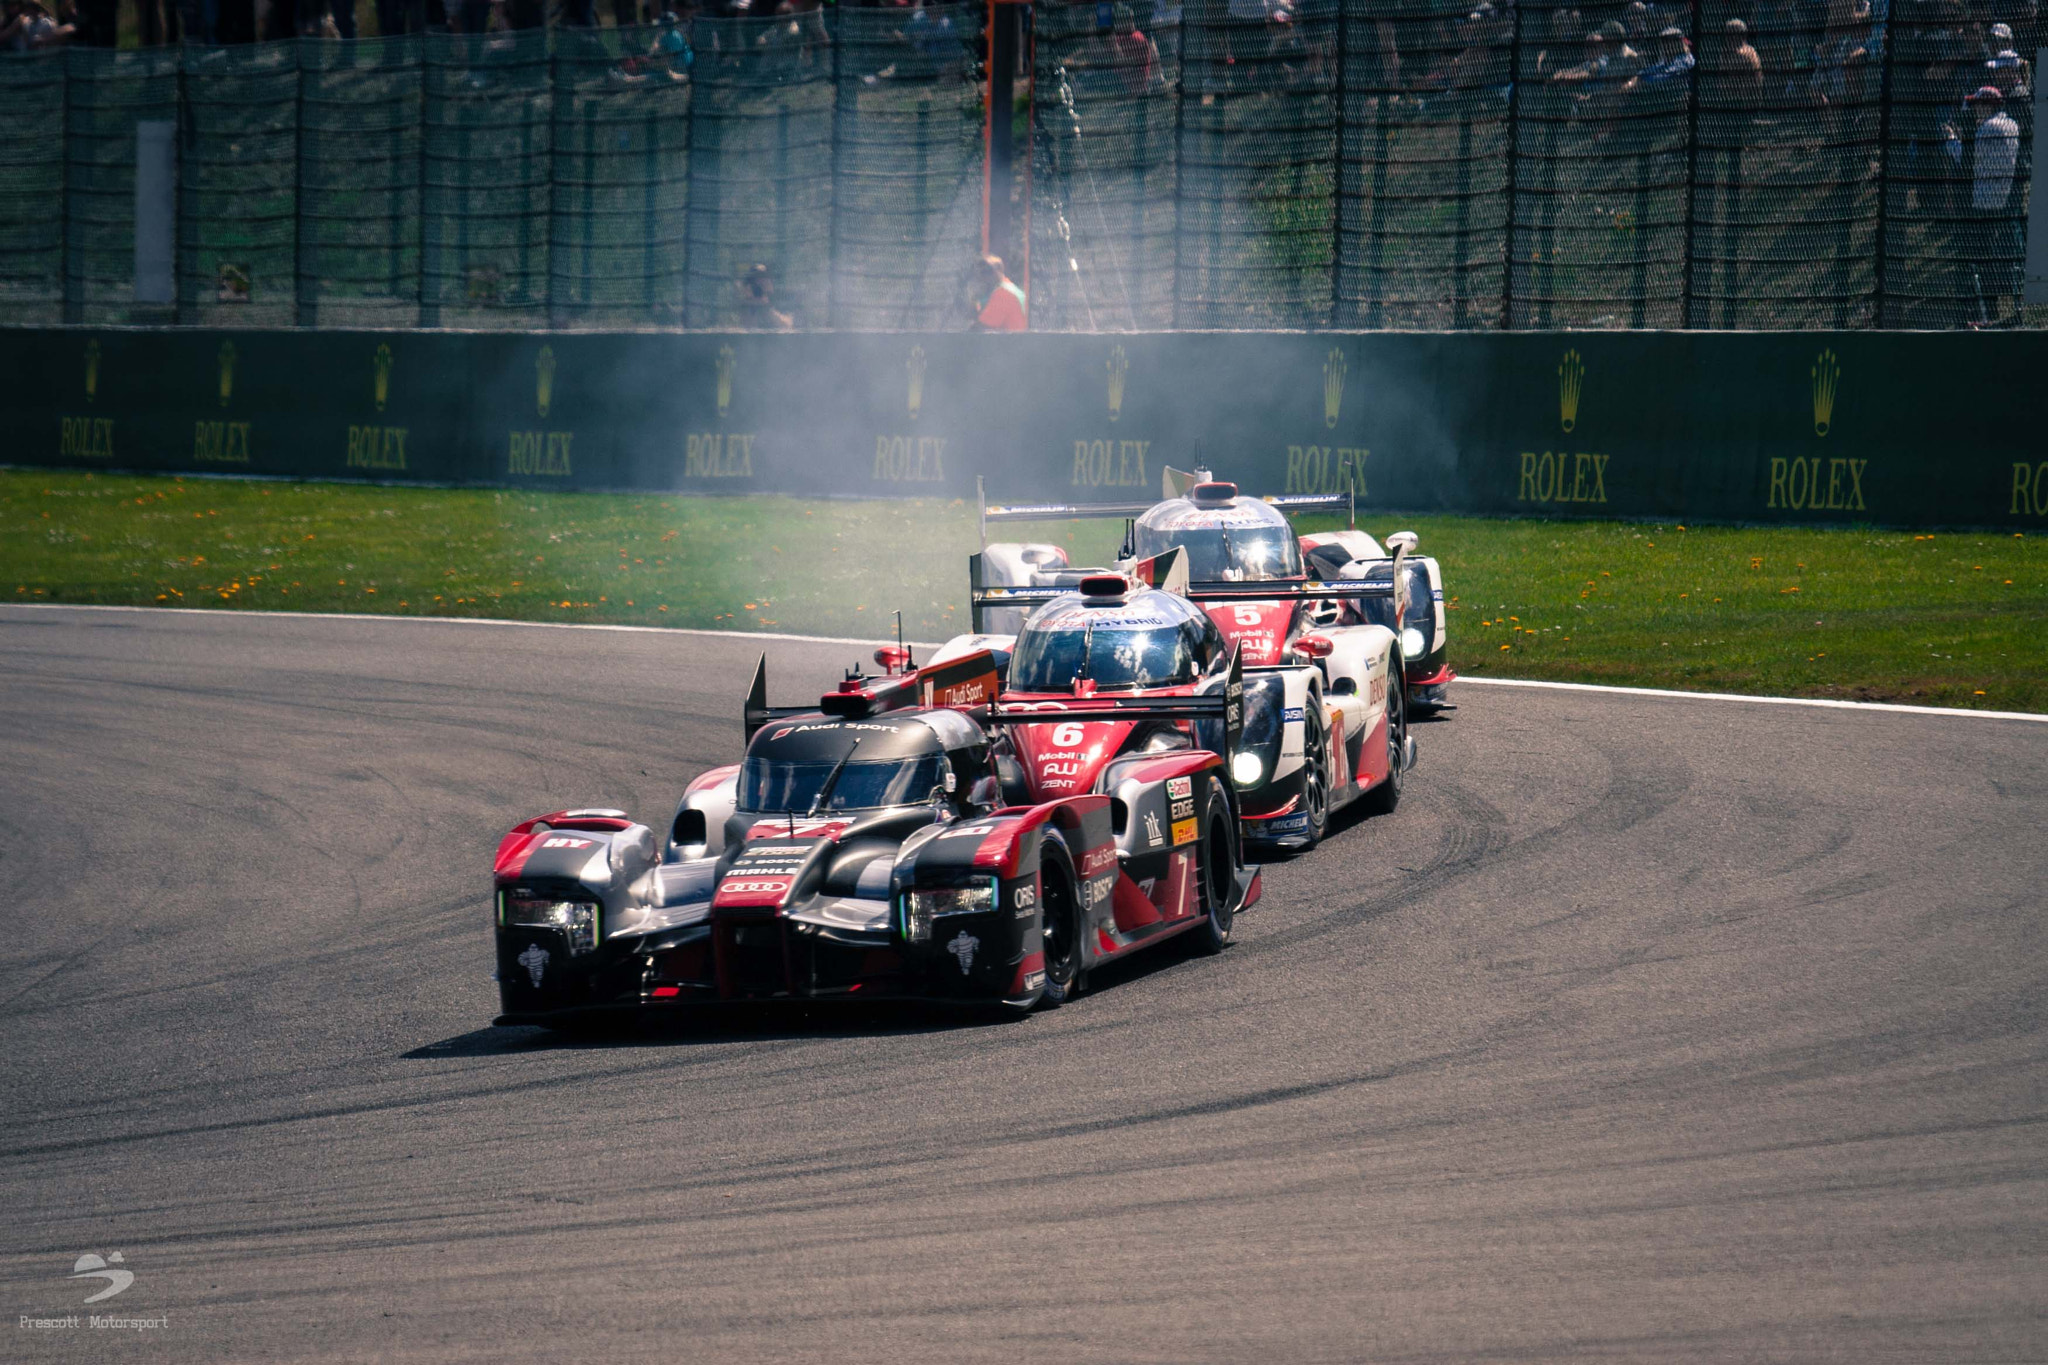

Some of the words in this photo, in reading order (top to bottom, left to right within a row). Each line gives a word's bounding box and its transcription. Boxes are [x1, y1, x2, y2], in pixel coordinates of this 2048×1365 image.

[60, 417, 114, 457] ROLEX
[193, 421, 249, 463] ROLEX
[346, 425, 408, 470] ROLEX
[508, 431, 573, 476] ROLEX
[685, 433, 755, 477] ROLEX
[872, 435, 947, 482] ROLEX
[1072, 440, 1150, 487] ROLEX
[1285, 445, 1369, 497] ROLEX
[1520, 452, 1609, 502] ROLEX
[1767, 456, 1867, 510] ROLEX
[1234, 605, 1262, 626] 5
[796, 723, 840, 732] Audi
[845, 722, 900, 734] Sport
[1052, 722, 1085, 747] 6
[1038, 751, 1075, 762] Mobil
[1041, 780, 1077, 789] ZENT
[1171, 799, 1195, 820] EDGE
[541, 838, 593, 849] HY
[727, 867, 801, 877] MAHLE
[1177, 851, 1188, 916] 7
